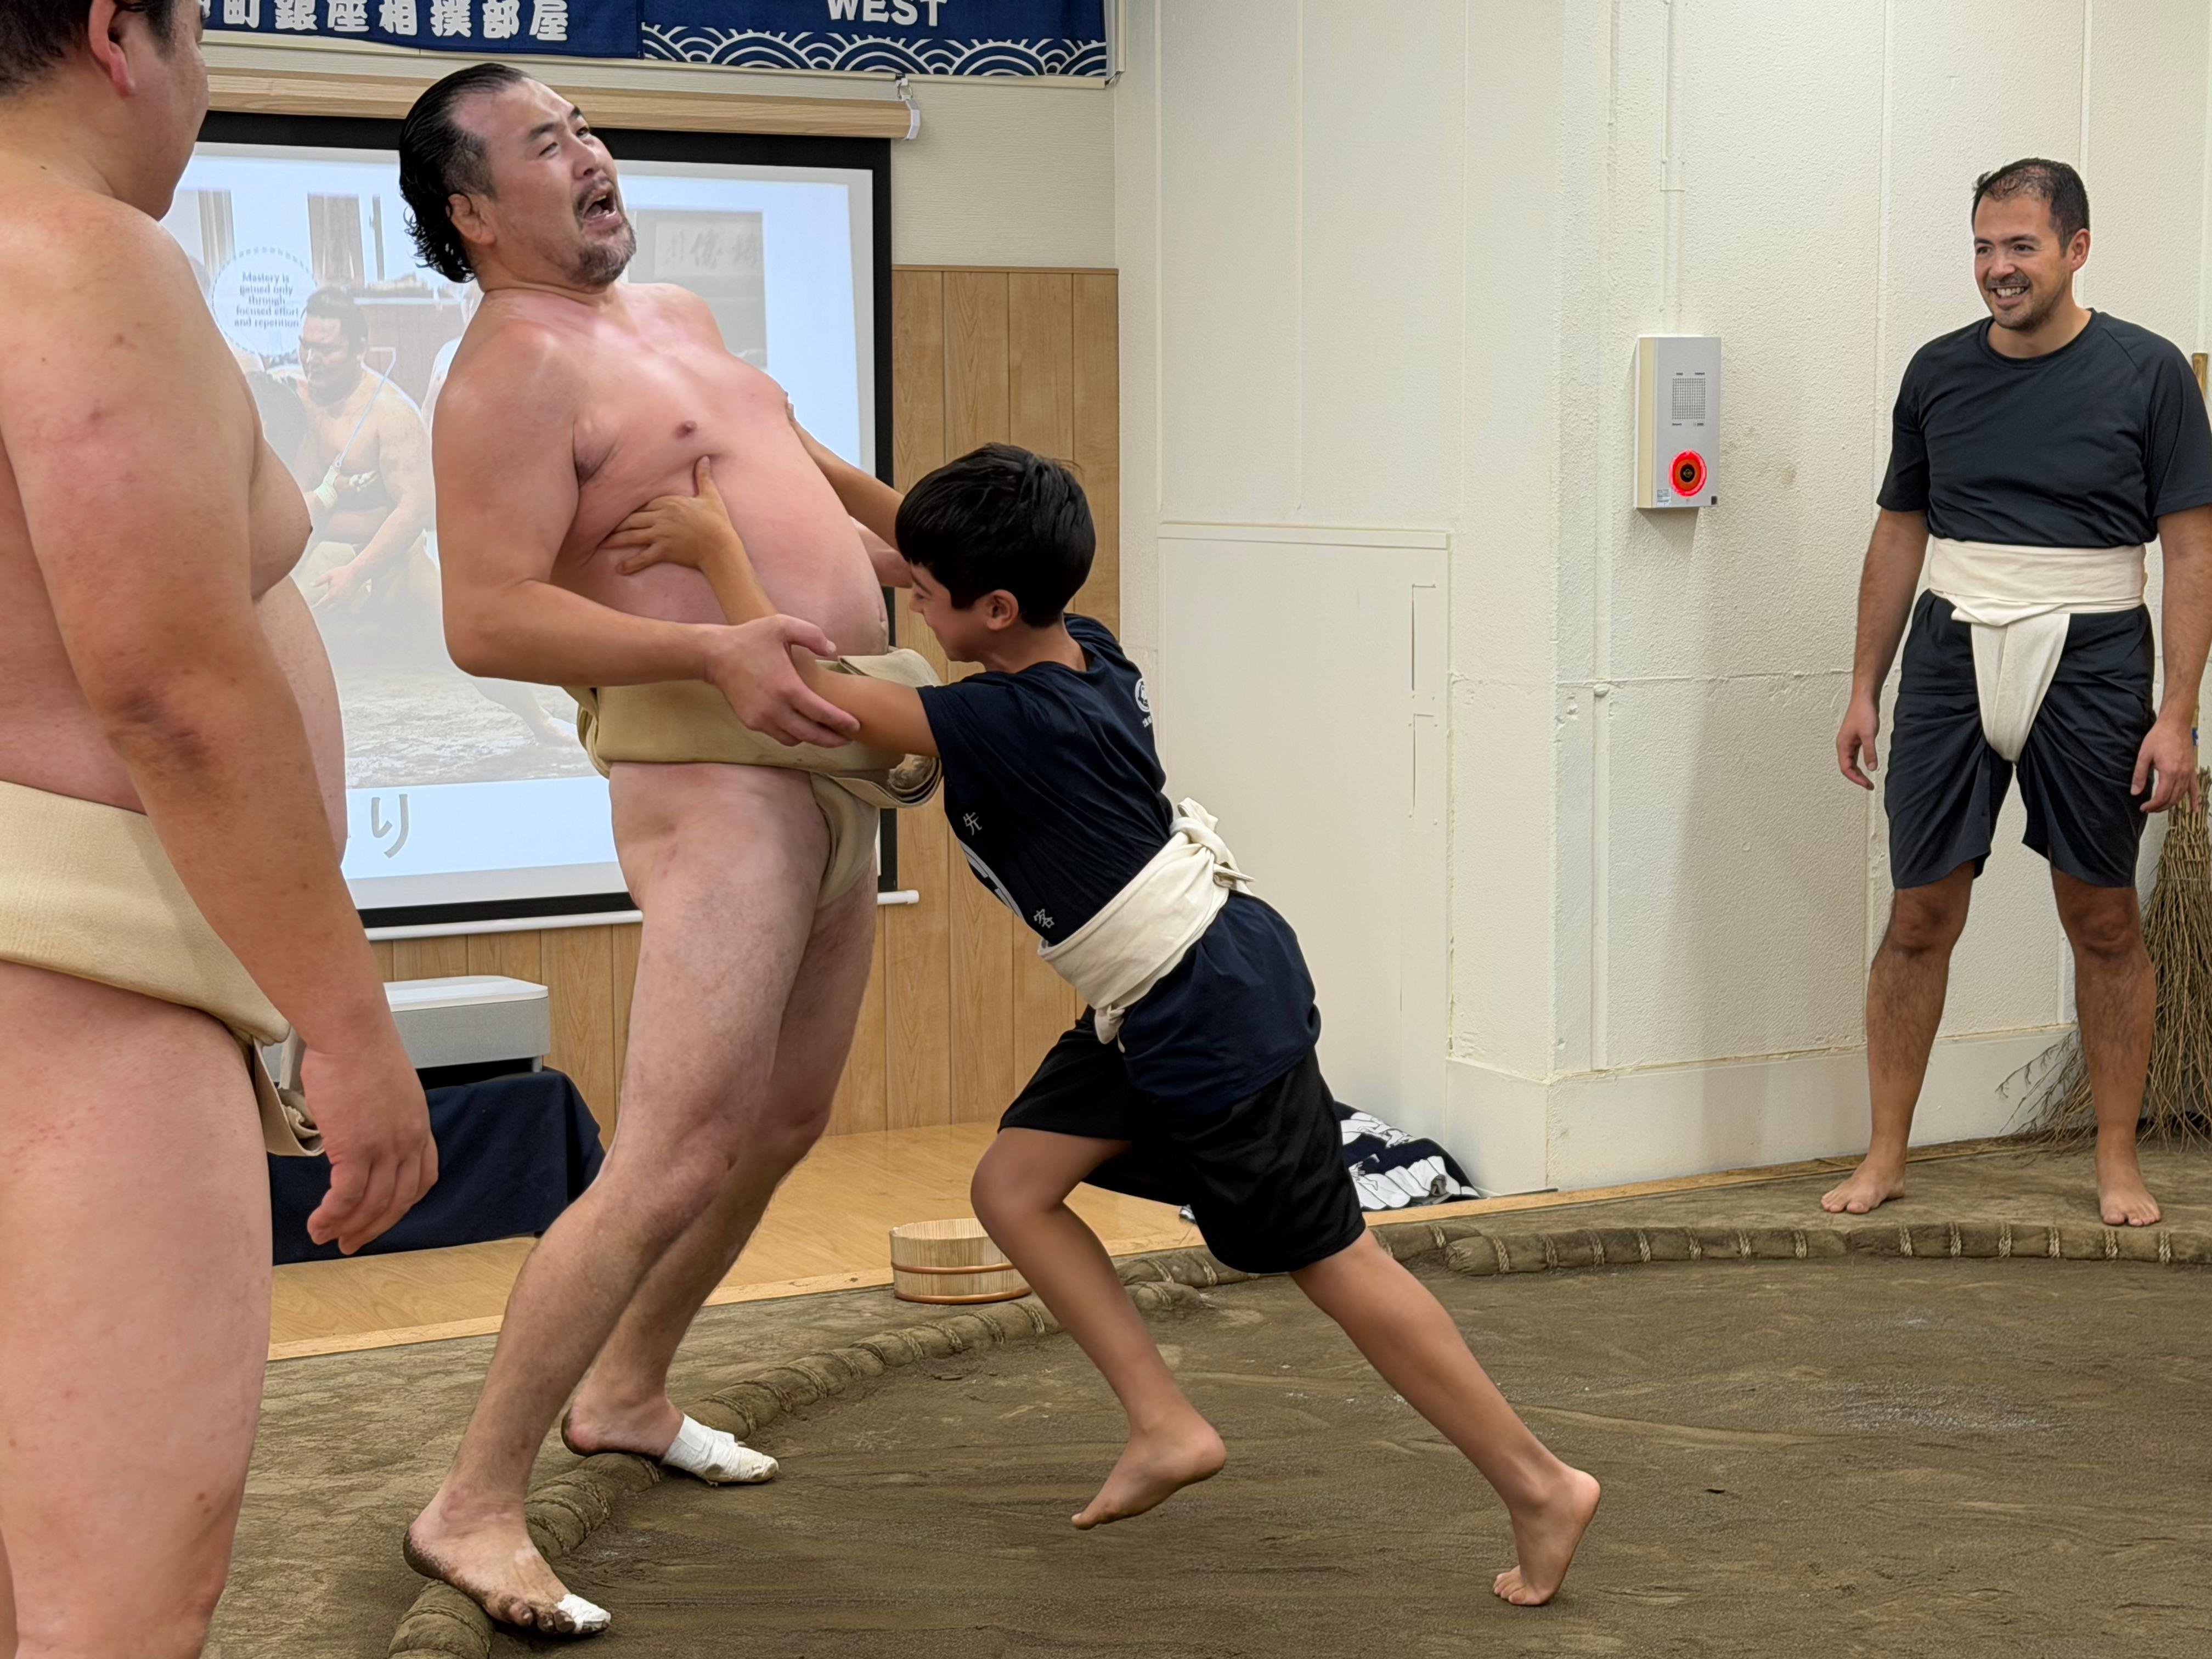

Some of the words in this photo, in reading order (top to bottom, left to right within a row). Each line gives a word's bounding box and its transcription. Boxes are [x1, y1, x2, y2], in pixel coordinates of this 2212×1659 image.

[827, 0, 947, 26] WEST
[200, 0, 568, 41] 町銀座相撲部屋
[242, 272, 279, 285] Mastery
[282, 273, 289, 283] is
[240, 283, 270, 296] gained
[273, 284, 293, 297] only
[249, 295, 285, 306] through
[236, 305, 272, 315] focused
[274, 307, 298, 316] effort
[234, 317, 251, 327] and
[255, 318, 299, 330] repetition
